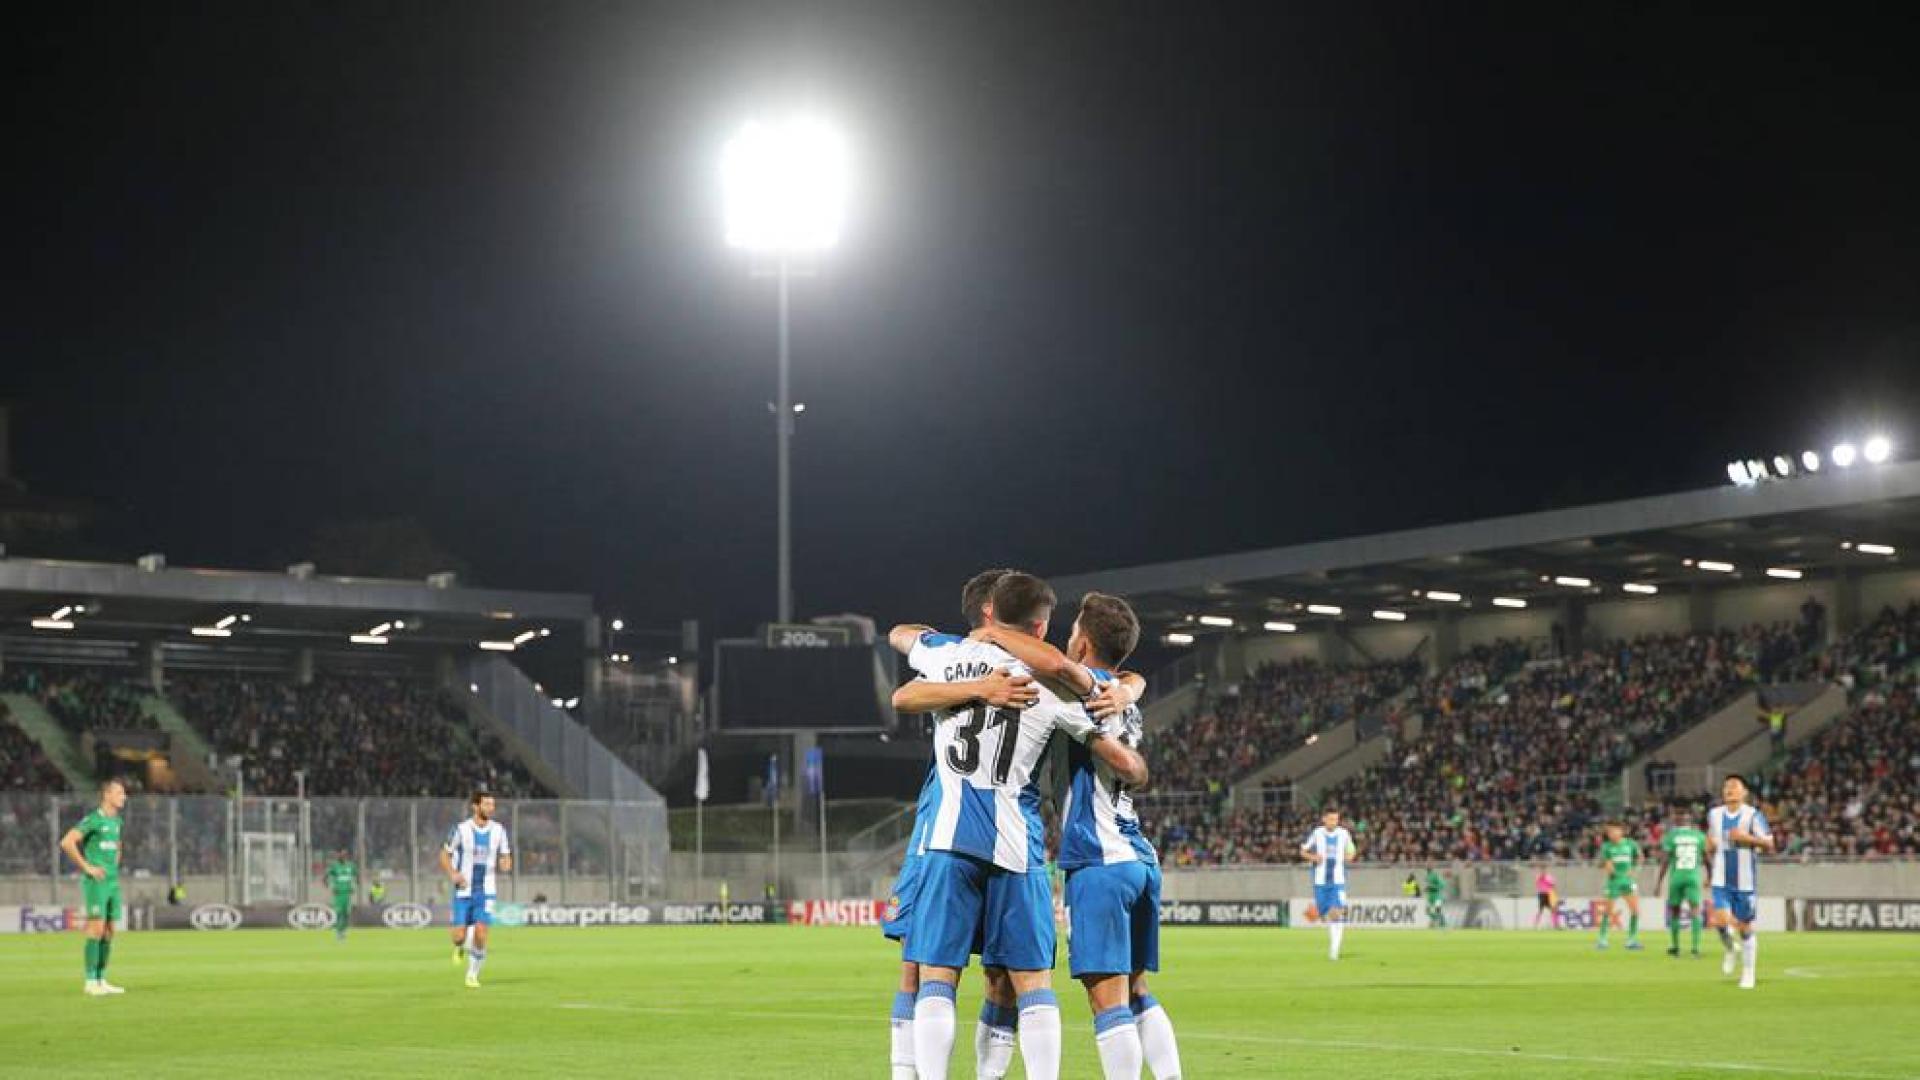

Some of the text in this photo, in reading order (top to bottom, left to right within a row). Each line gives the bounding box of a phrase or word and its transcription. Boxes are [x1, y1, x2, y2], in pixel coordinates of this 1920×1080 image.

[21, 906, 83, 931] FedE
[198, 906, 239, 927] KIA
[294, 906, 332, 927] KIA
[388, 906, 427, 926] KIA
[500, 902, 649, 927] enterprise
[812, 901, 877, 926] AMSTEL
[1207, 903, 1278, 923] RENT-A-CAR
[1814, 903, 1920, 928] UEFA EUR
